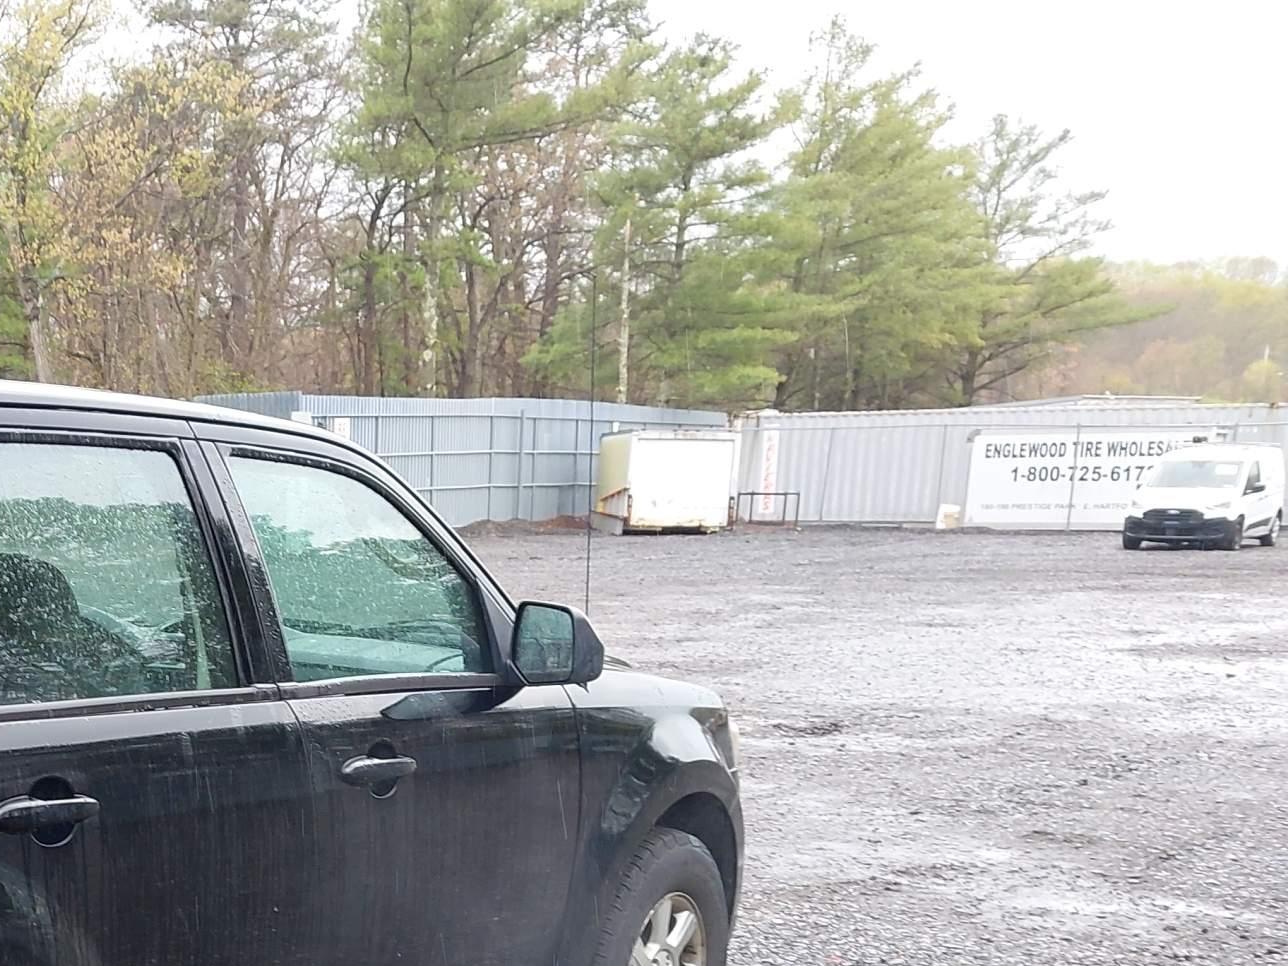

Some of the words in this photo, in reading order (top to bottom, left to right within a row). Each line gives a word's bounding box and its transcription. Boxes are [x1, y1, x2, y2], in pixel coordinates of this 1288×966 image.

[984, 441, 1067, 459] ENGLEWOOD
[1072, 440, 1103, 458] TIRE
[1011, 465, 1155, 483] 1-800-725-617
